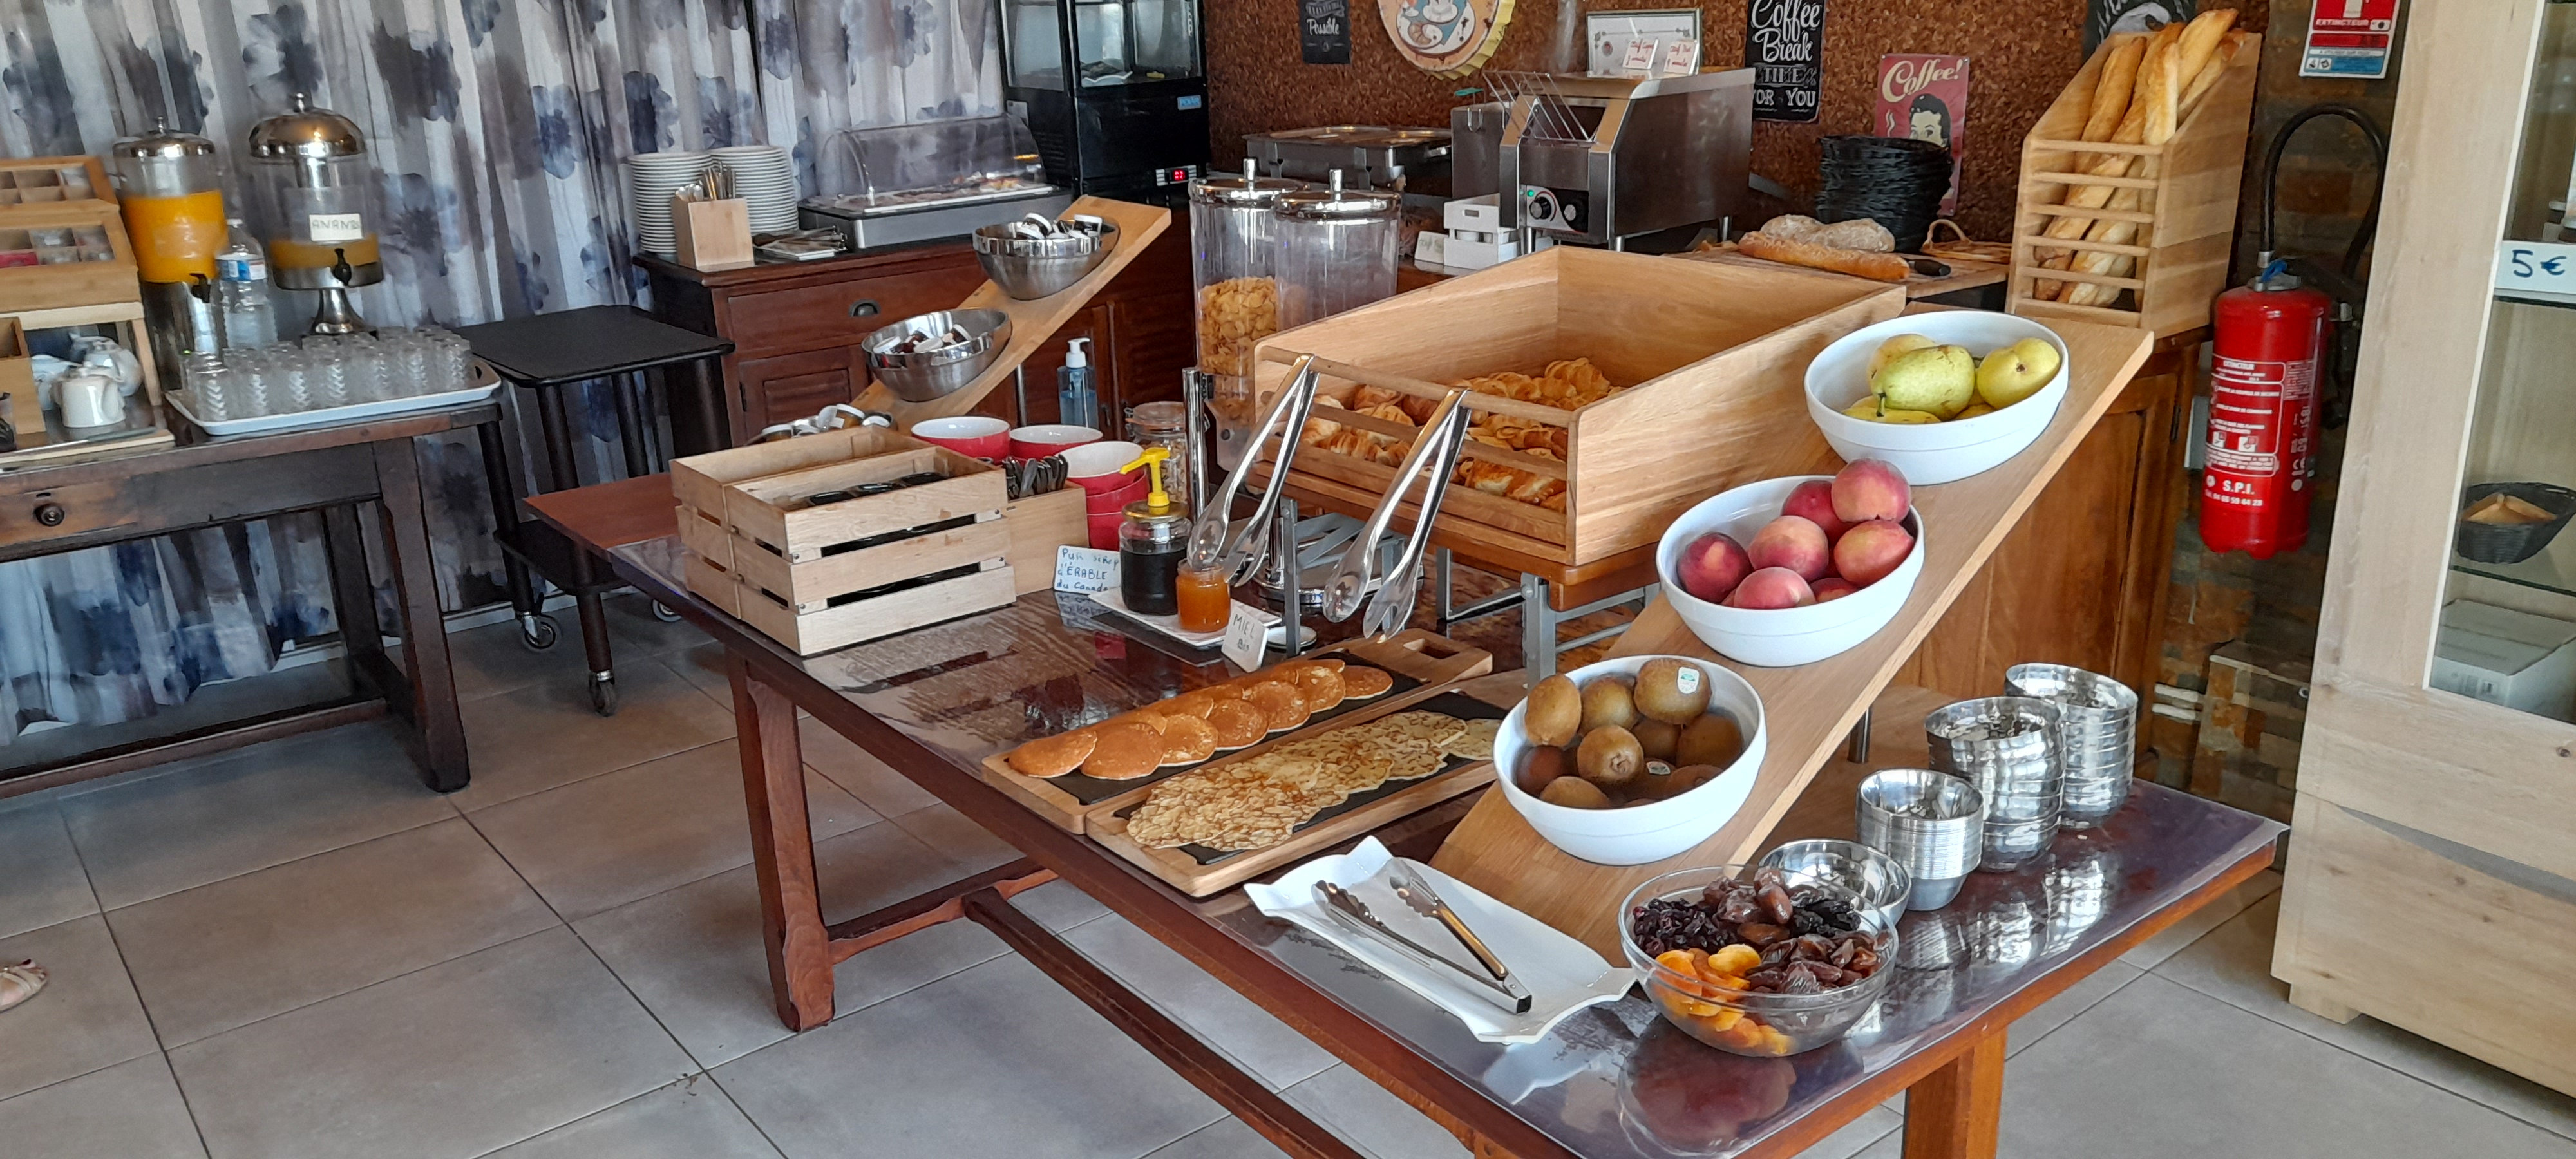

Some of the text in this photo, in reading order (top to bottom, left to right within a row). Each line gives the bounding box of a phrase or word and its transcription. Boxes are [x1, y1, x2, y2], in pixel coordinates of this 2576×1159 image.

[1752, 0, 1821, 42] Coffee
[1754, 28, 1814, 62] Break
[1764, 67, 1803, 83] TIME
[1882, 58, 1964, 103] Coffee!
[1754, 87, 1817, 108] OR YOU
[2222, 479, 2255, 495] S.P.I.
[1056, 578, 1109, 592] du Canada
[1233, 613, 1255, 639] MIEL
